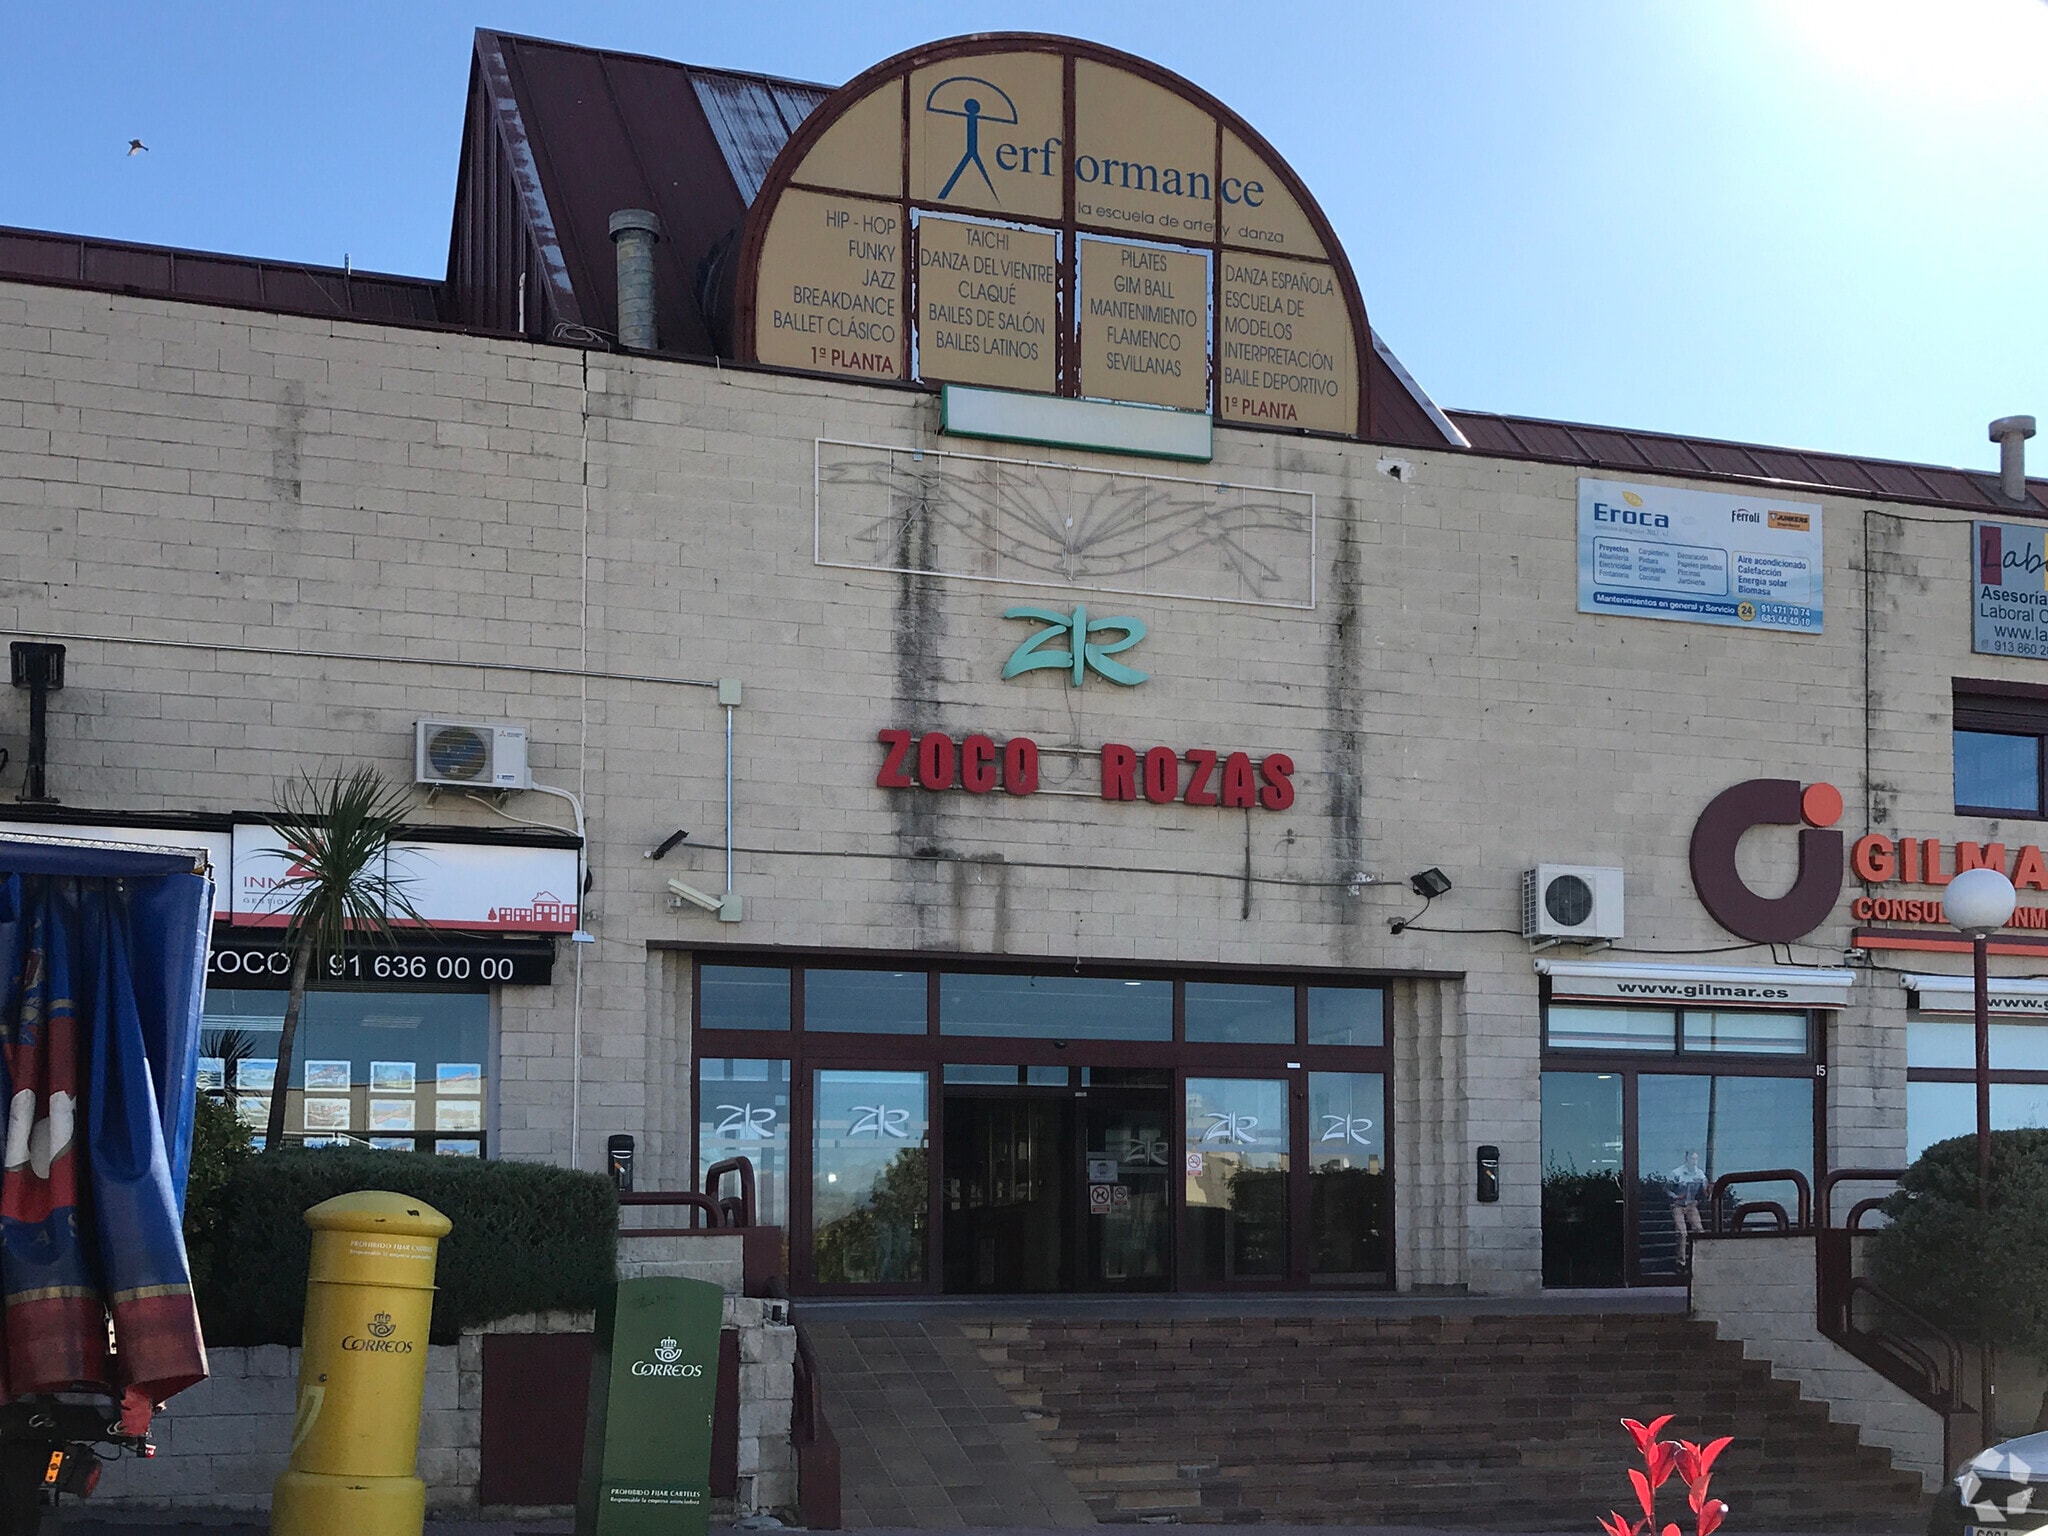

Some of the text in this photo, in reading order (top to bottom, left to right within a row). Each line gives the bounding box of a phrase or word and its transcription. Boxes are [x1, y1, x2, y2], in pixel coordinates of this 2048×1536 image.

[826, 209, 849, 228] HIP
[863, 215, 896, 235] HOP
[1078, 202, 1284, 243] la escuela de arte y danza
[849, 239, 895, 263] FUNKY
[966, 228, 1009, 250] TAICHI
[920, 248, 1054, 284] DANZA DEL VIENTRE
[1121, 249, 1167, 272] PILATES
[862, 269, 895, 290] JAZZ
[1114, 275, 1175, 299] GIM BALL
[1225, 264, 1334, 296] DANZA ESPAÑOLA
[793, 285, 895, 317] BREAKDANCE
[958, 280, 1017, 305] CLAQUÉ
[1225, 290, 1305, 317] ESCUELA DE
[929, 302, 1045, 335] BAILES DE SALÓN
[1090, 297, 1197, 328] MANTENIMIENTO
[773, 310, 895, 343] BALLET CLÁSICO
[1107, 326, 1181, 351] FLAMENCO
[1225, 316, 1292, 340] MODELOS
[936, 330, 1039, 361] BAILES LATINOS
[1224, 341, 1333, 371] INTERPRETACIÓN
[831, 349, 894, 373] PLANTA
[1106, 352, 1181, 378] SEVILLANAS
[1225, 367, 1338, 397] BAILE DEPORTIVO
[1242, 399, 1298, 421] PLANTA
[1594, 502, 1669, 528] Eroca
[1738, 555, 1807, 570] Aire acondicionado
[1983, 540, 2048, 574] Lab
[1737, 565, 1782, 577] Calefacción
[1769, 578, 1788, 588] solar
[1738, 585, 1771, 596] Biomasa
[1596, 593, 1658, 607] Mantenimientos
[1658, 600, 1669, 608] en
[1669, 600, 1698, 611] general
[1705, 604, 1736, 615] Servicio
[1741, 605, 1753, 616] 24
[1761, 604, 1810, 617] 91 471 70 74
[1980, 602, 2034, 622] Laboral
[1994, 640, 2014, 653] 913
[2017, 642, 2037, 655] 860
[876, 728, 1295, 812] ZOCO ROZAS
[329, 954, 360, 977] 91
[374, 955, 427, 978] 636
[436, 956, 470, 979] 00
[480, 957, 514, 980] 00
[1617, 983, 1789, 998] www.gilmar.es
[1816, 1064, 1826, 1077] 15
[342, 1335, 413, 1353] CORREOS
[631, 1360, 703, 1377] CORREOS
[610, 1488, 650, 1496] PROHIBIDO
[669, 1490, 701, 1498] CARTELES
